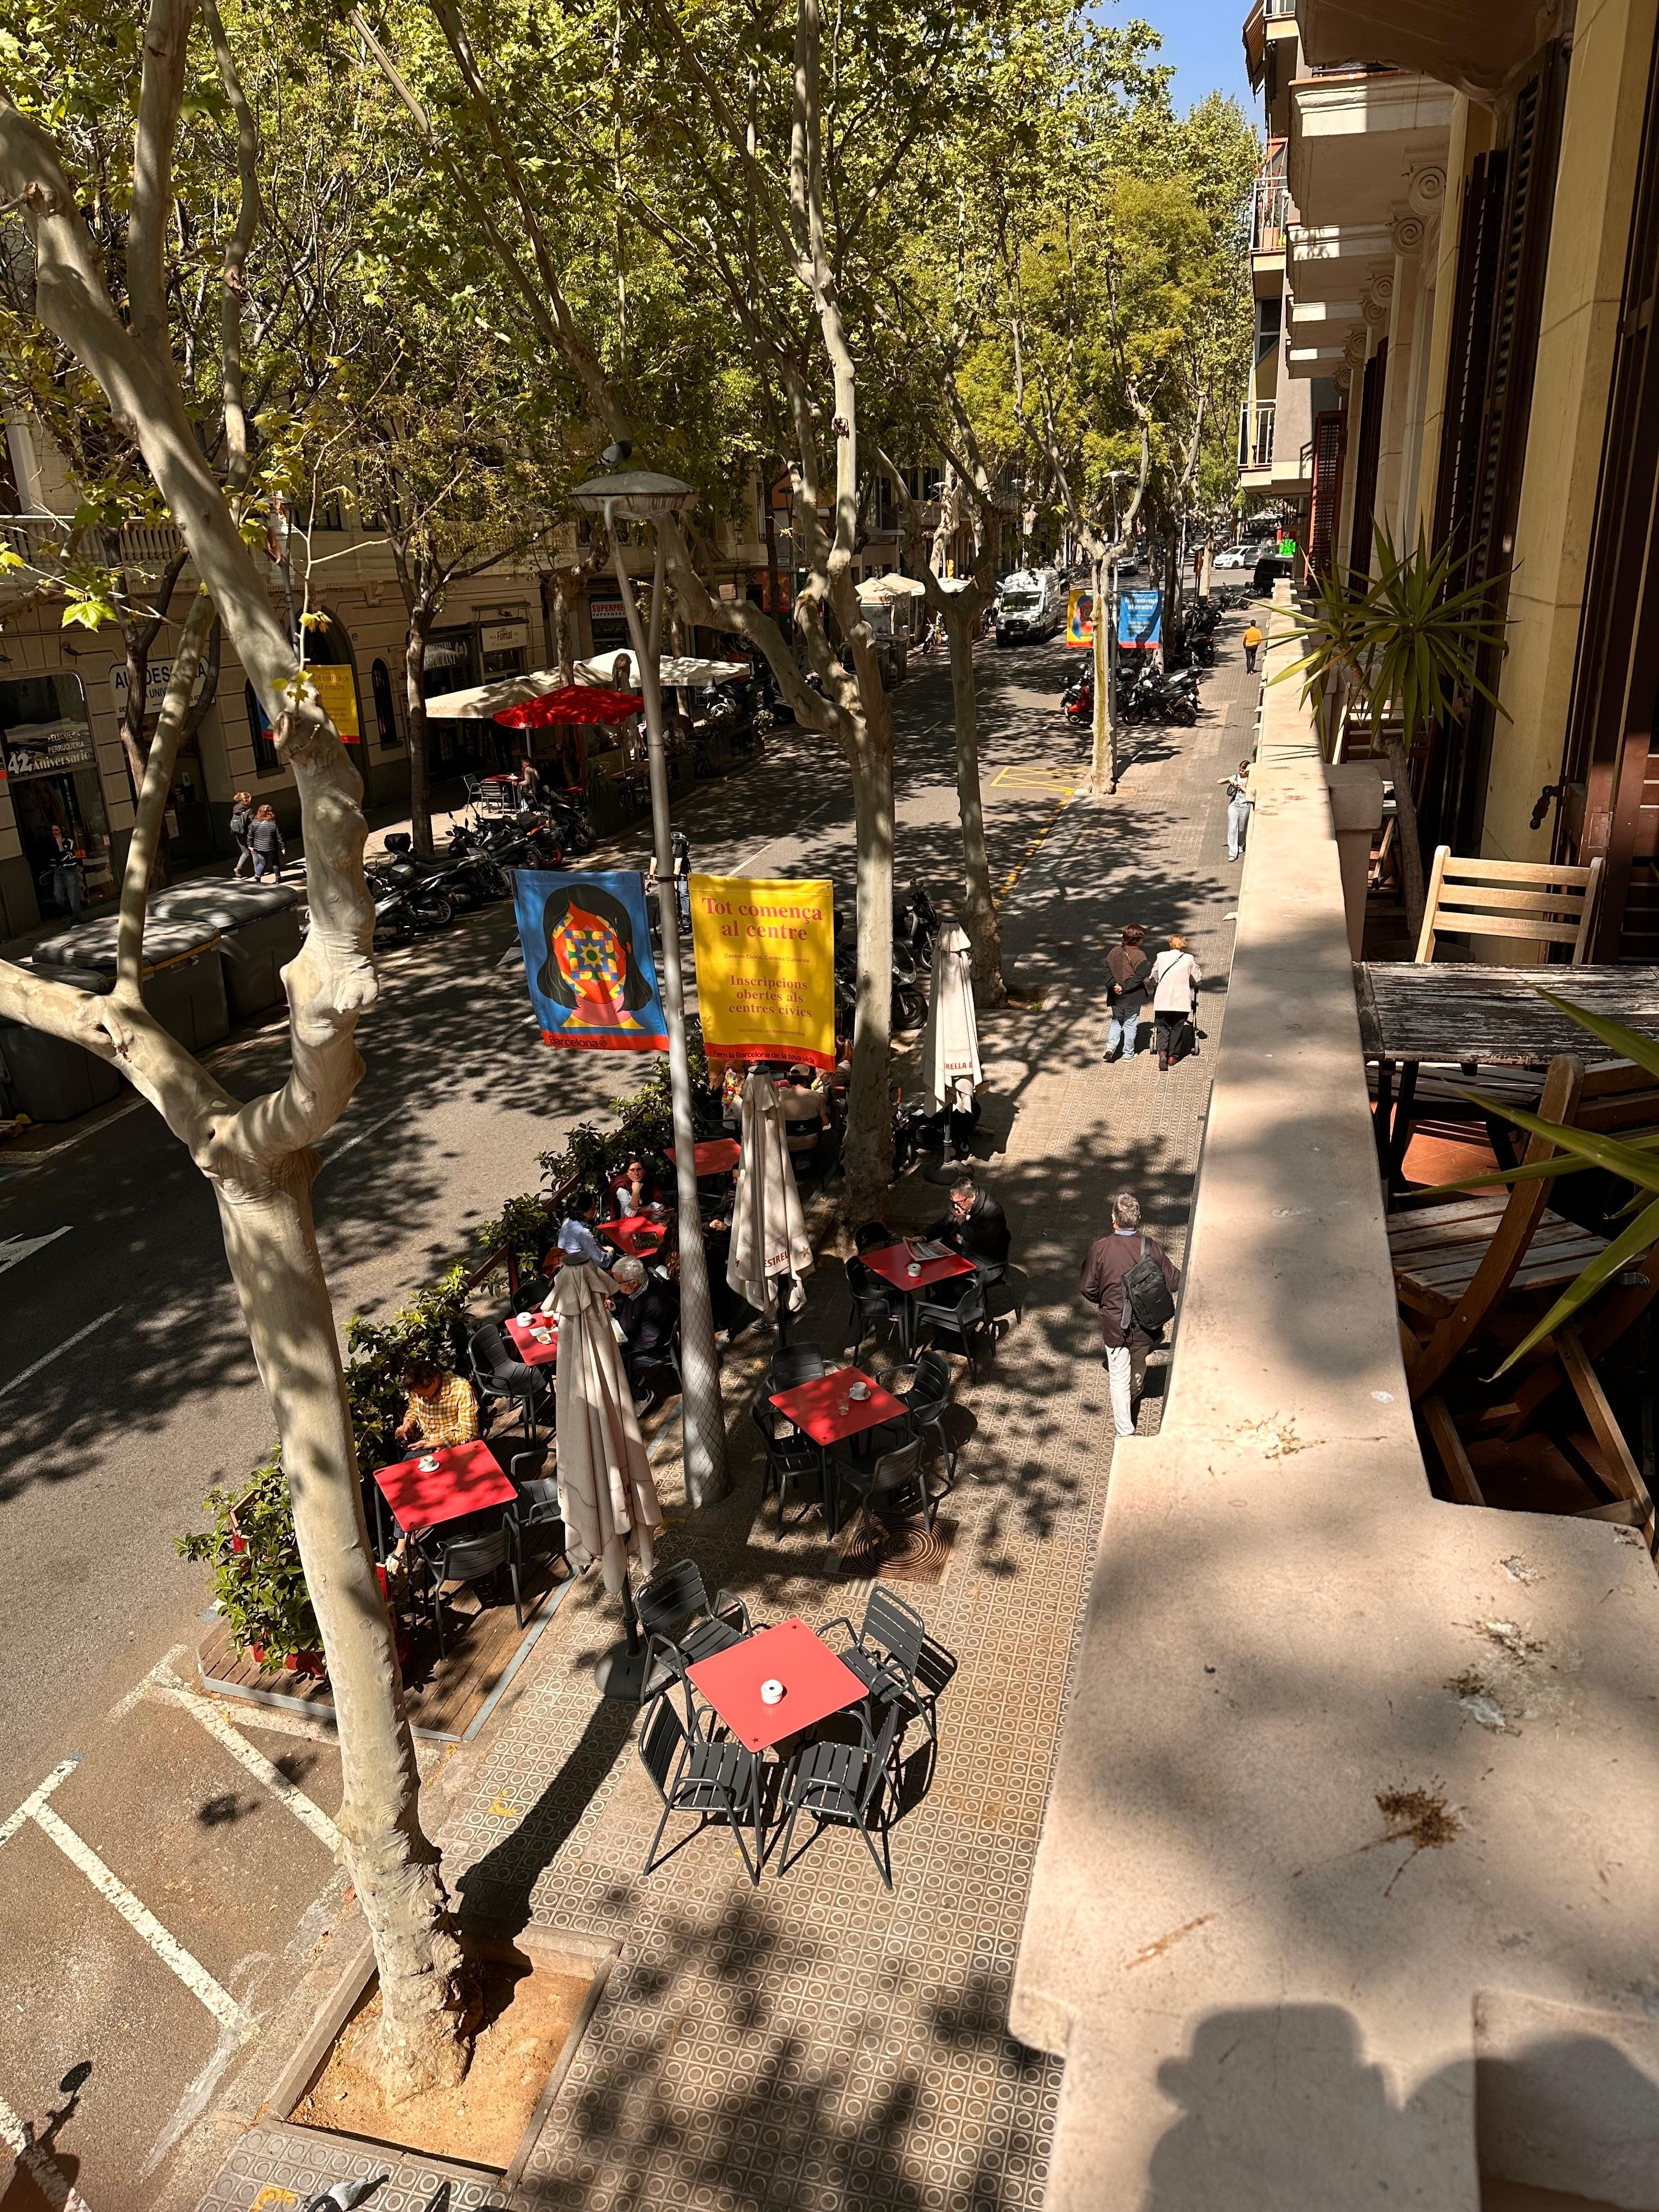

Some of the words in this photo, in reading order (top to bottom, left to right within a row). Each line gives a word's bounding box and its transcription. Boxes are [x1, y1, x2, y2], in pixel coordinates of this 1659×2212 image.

[592, 604, 625, 612] SUPERPRE
[48, 741, 85, 754] PERRUQUERIA
[8, 752, 32, 774] 42
[33, 749, 91, 770] Aniversario
[702, 898, 733, 915] Tot
[738, 904, 823, 924] comença
[722, 921, 740, 936] al
[746, 924, 808, 940] centre
[730, 975, 808, 989] Inscripcions
[736, 989, 782, 1001] obertes
[787, 992, 804, 1003] als
[729, 1003, 774, 1014] centres
[778, 1005, 812, 1018] cívics
[549, 1035, 598, 1048] Barcelona
[713, 1049, 727, 1058] Fem
[803, 1056, 815, 1064] vida
